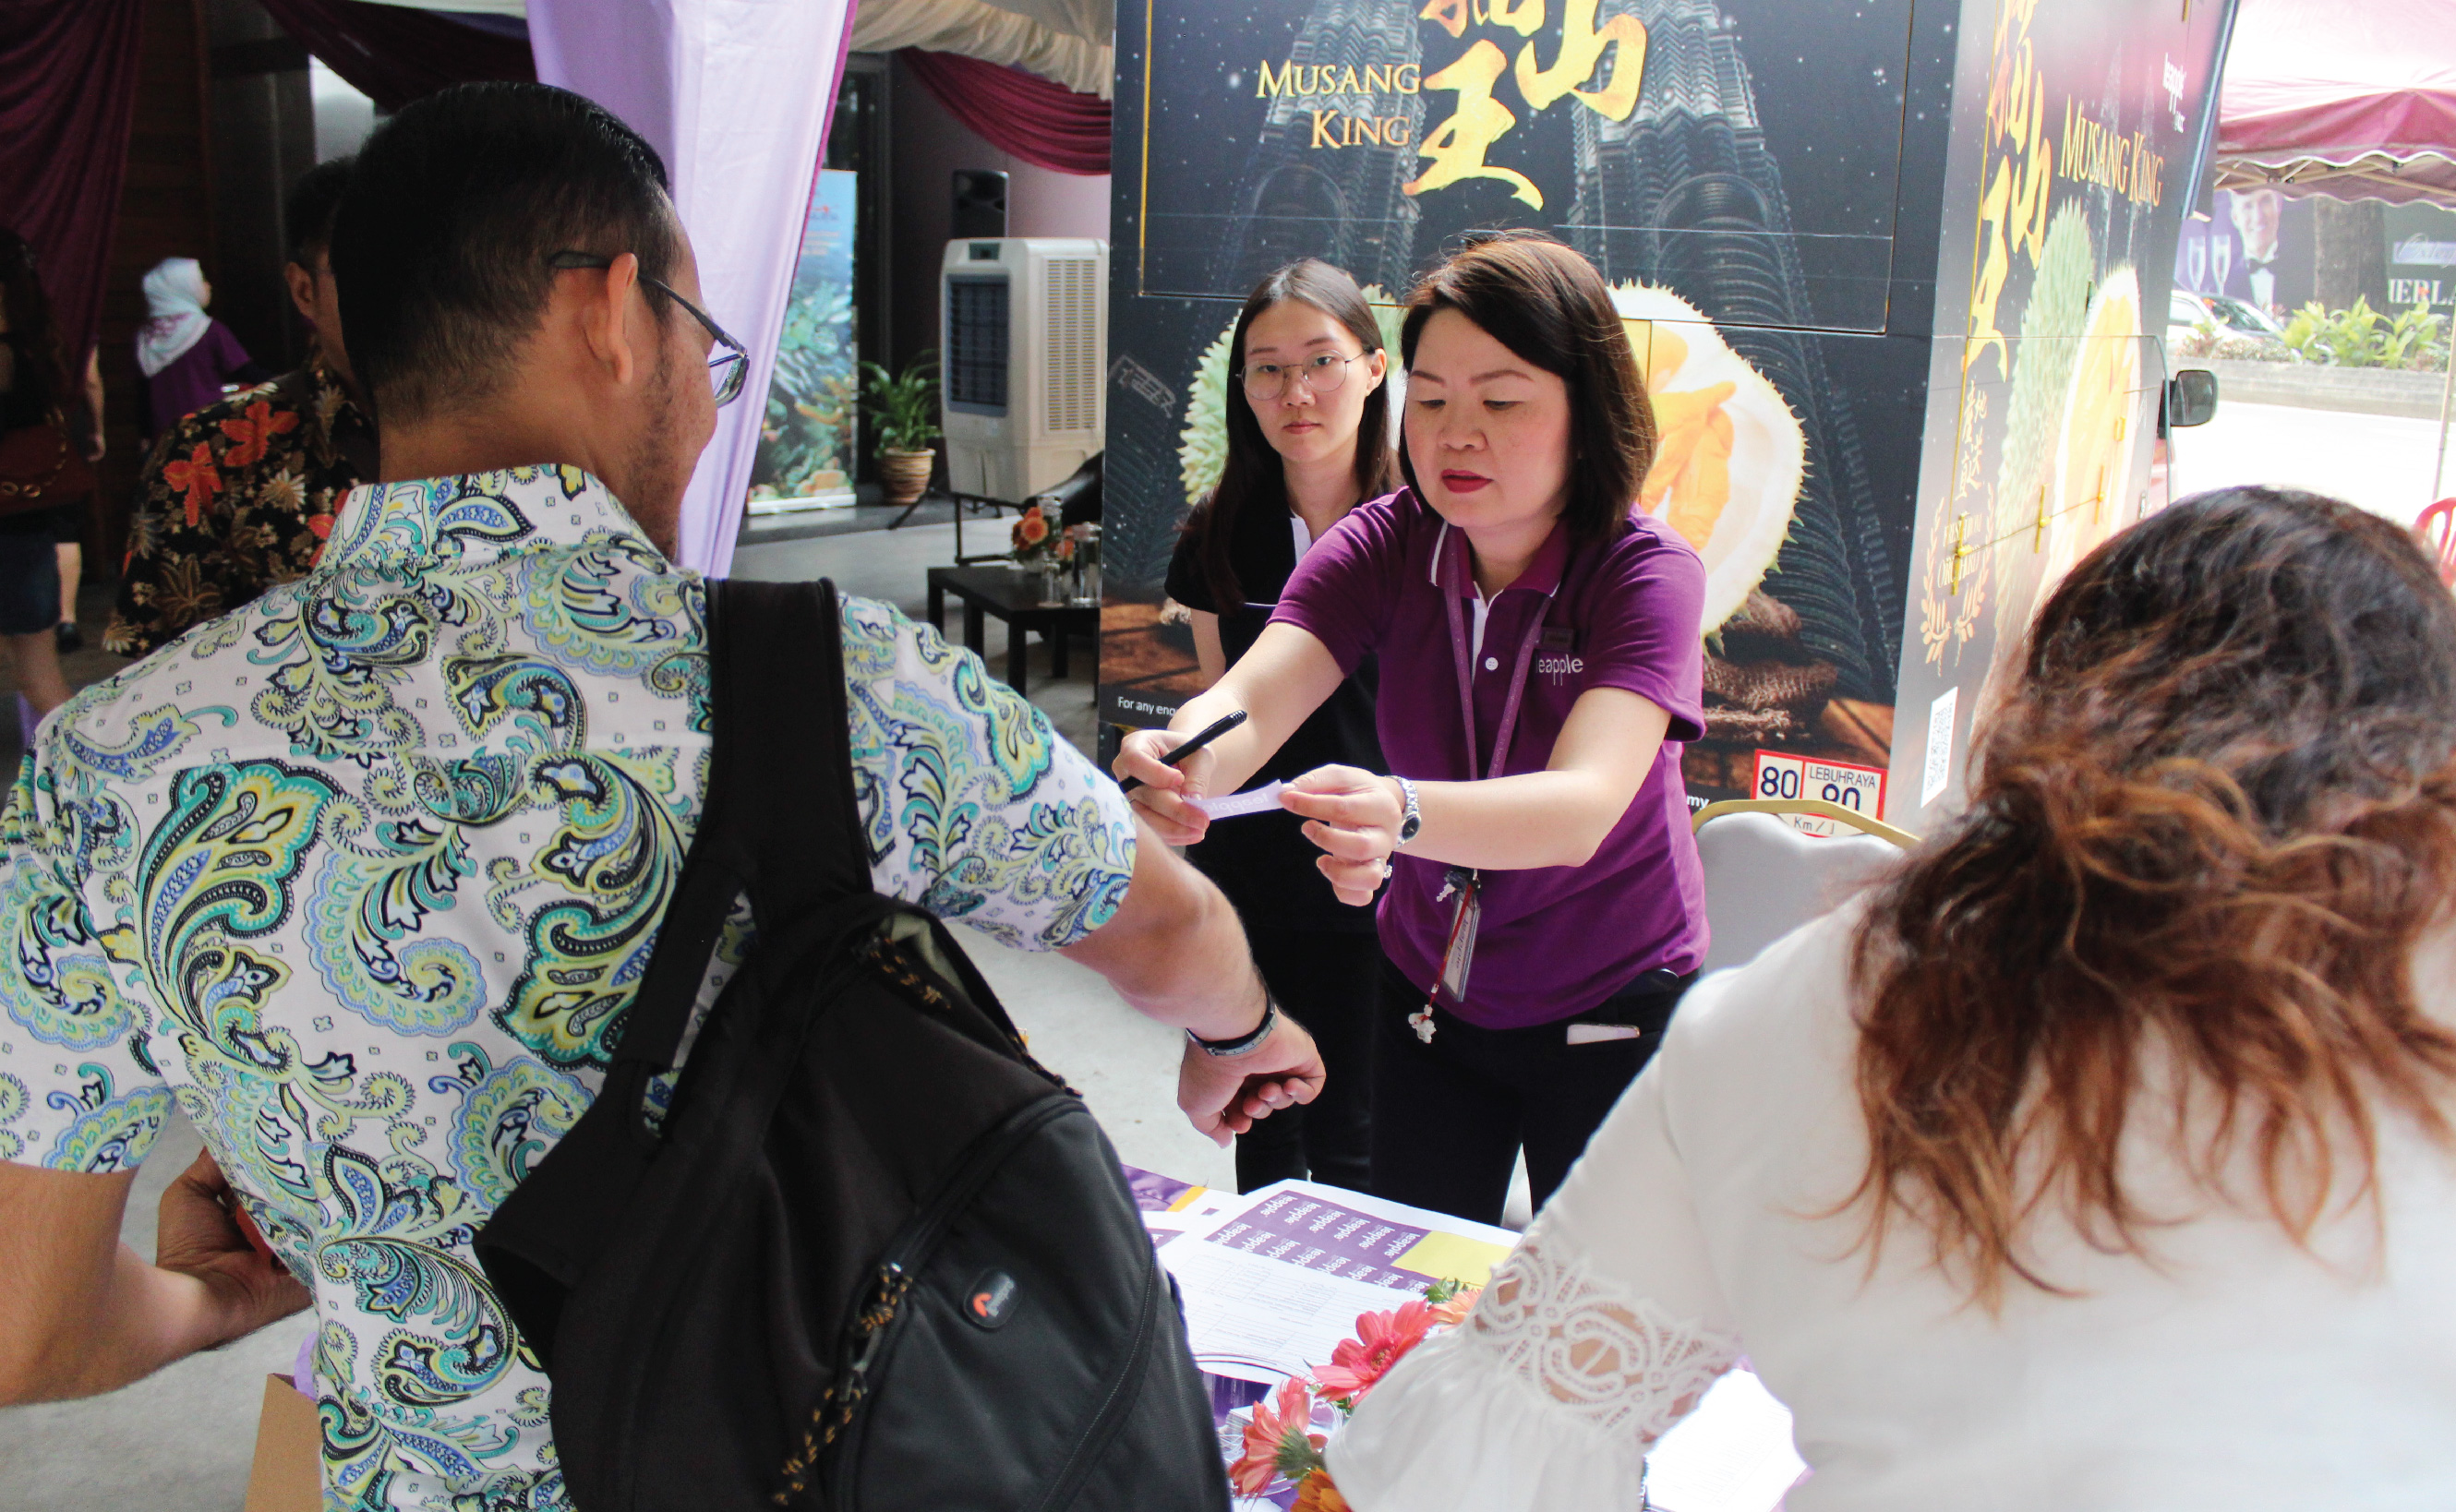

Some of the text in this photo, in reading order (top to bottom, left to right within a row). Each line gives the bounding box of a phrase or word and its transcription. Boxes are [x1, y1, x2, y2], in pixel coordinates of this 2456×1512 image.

[1256, 59, 1422, 98] MUSANG
[1310, 109, 1411, 149] KING
[2058, 93, 2164, 207] MUSANG KING
[1117, 696, 1135, 709] For
[1136, 702, 1154, 715] any
[1760, 766, 1799, 799] 80
[1810, 765, 1876, 789] LEBUHRAYA
